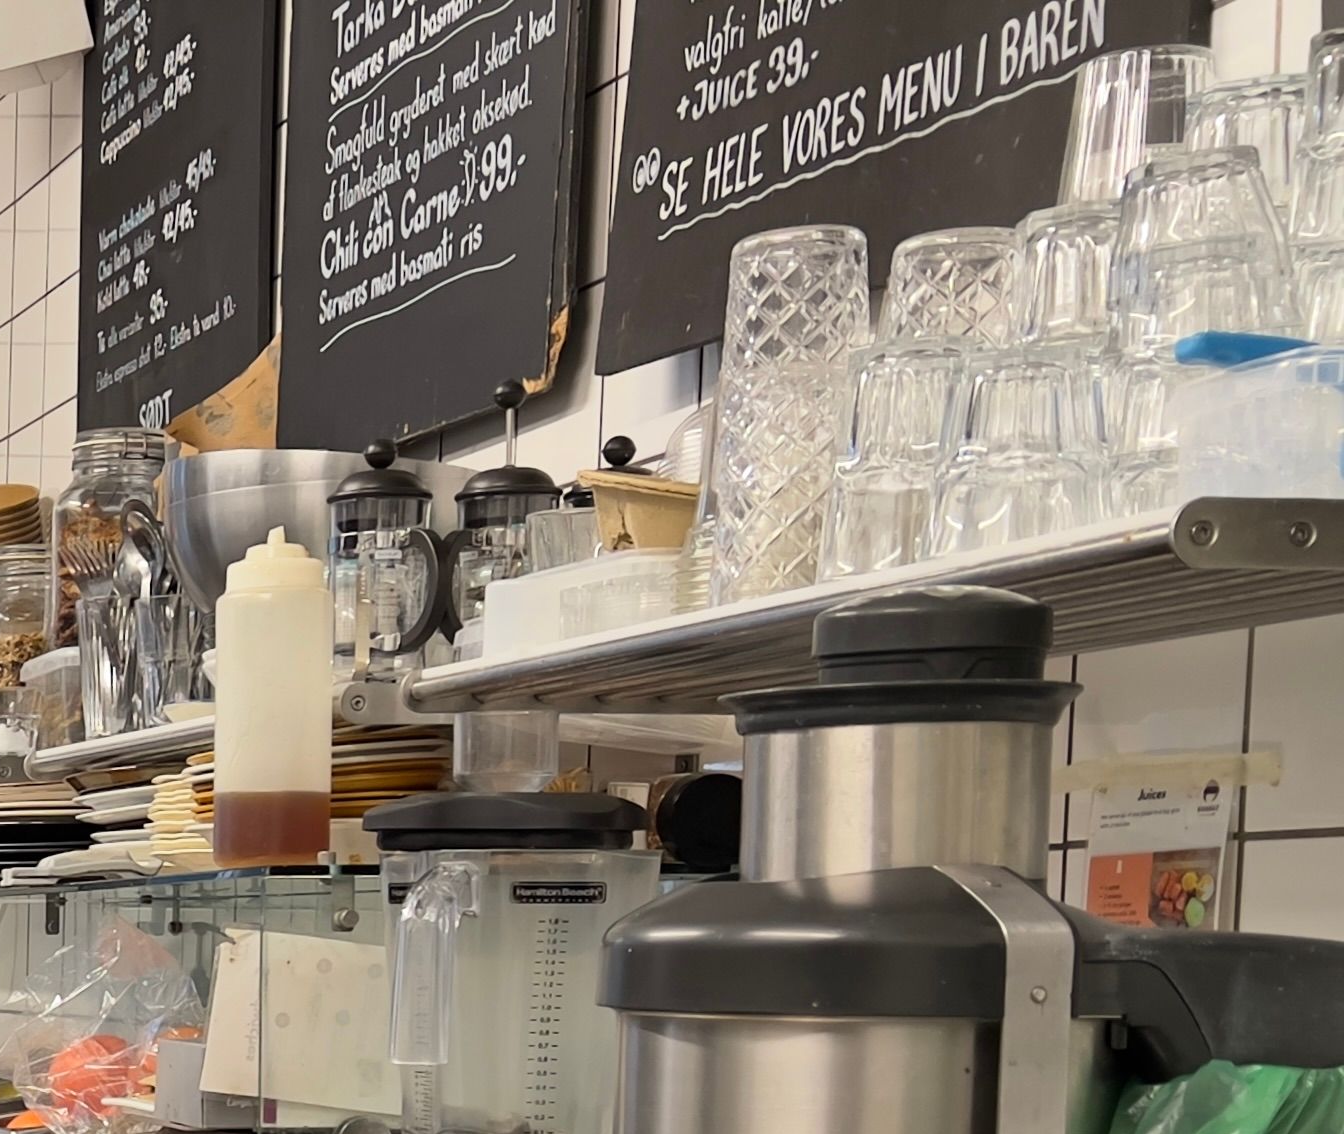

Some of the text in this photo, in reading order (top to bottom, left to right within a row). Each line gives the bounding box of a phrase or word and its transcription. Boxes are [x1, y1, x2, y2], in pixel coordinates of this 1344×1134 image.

[330, 47, 384, 105] Serveres
[388, 10, 416, 66] med
[331, 0, 386, 58] Tarka
[684, 5, 747, 74] valgfri
[325, 0, 557, 175] Smagfuld gryderet med skært kød
[659, 0, 1106, 220] SE HELE VORES MENU I BAREN
[322, 64, 533, 222] af flankesteak og hakket oksekød.
[319, 224, 484, 325] Serveres med basmati ris
[320, 220, 360, 280] Chili
[363, 217, 395, 260] con
[400, 188, 461, 240] Carne
